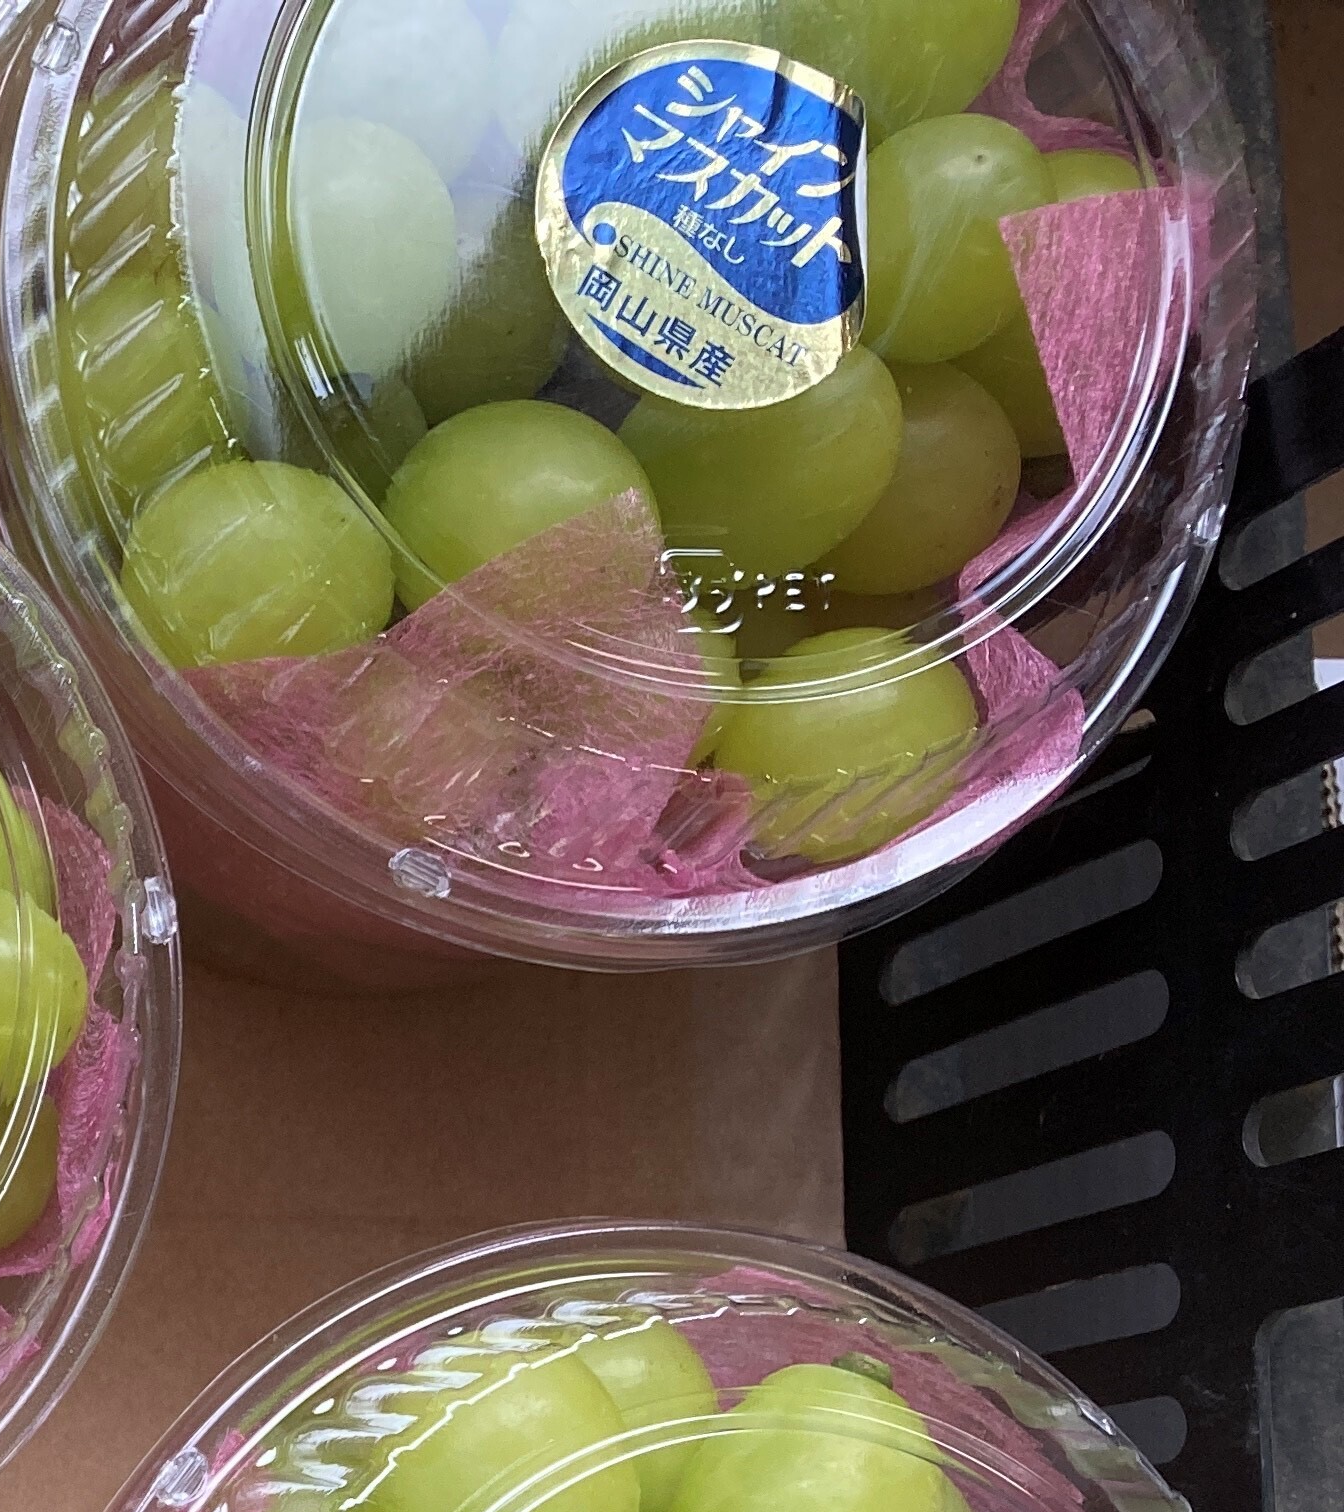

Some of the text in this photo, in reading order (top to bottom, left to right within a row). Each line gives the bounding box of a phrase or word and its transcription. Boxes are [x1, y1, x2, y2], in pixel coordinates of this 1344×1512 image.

[621, 104, 852, 268] マスカット
[666, 65, 856, 198] シャイン
[614, 233, 807, 368] SHINE MUSCAT
[672, 204, 745, 265] 種なし
[577, 264, 736, 387] 岡山県産
